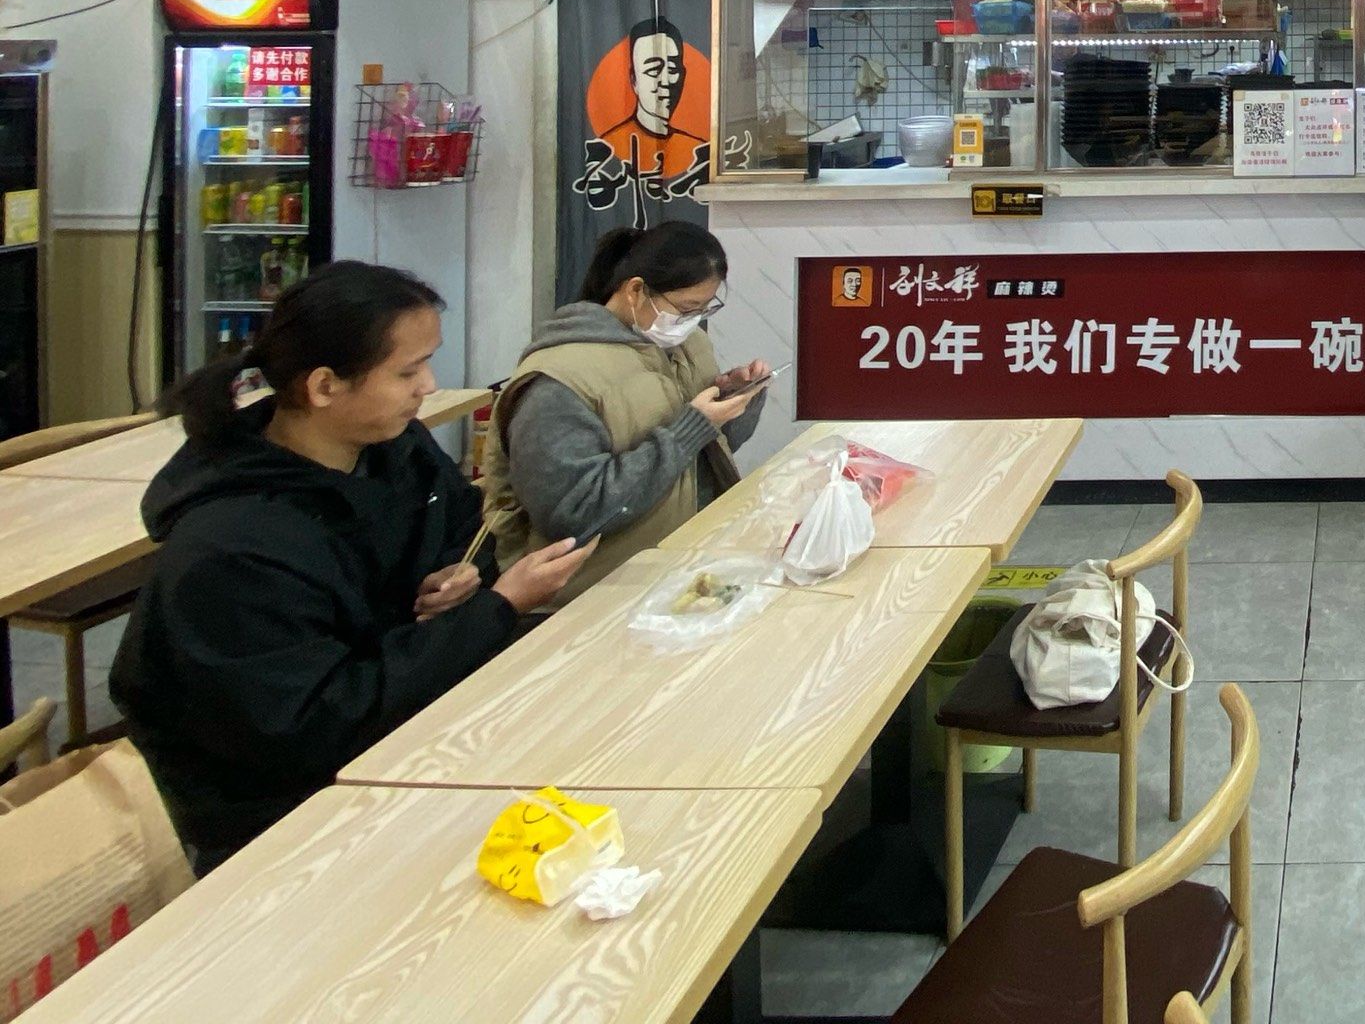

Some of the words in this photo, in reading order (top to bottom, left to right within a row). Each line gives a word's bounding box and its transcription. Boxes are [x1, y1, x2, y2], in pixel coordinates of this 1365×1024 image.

[252, 51, 309, 65] 请先付款
[252, 67, 309, 82] 多谢合作
[994, 281, 1058, 296] 麻辣烫
[859, 319, 984, 373] 20年
